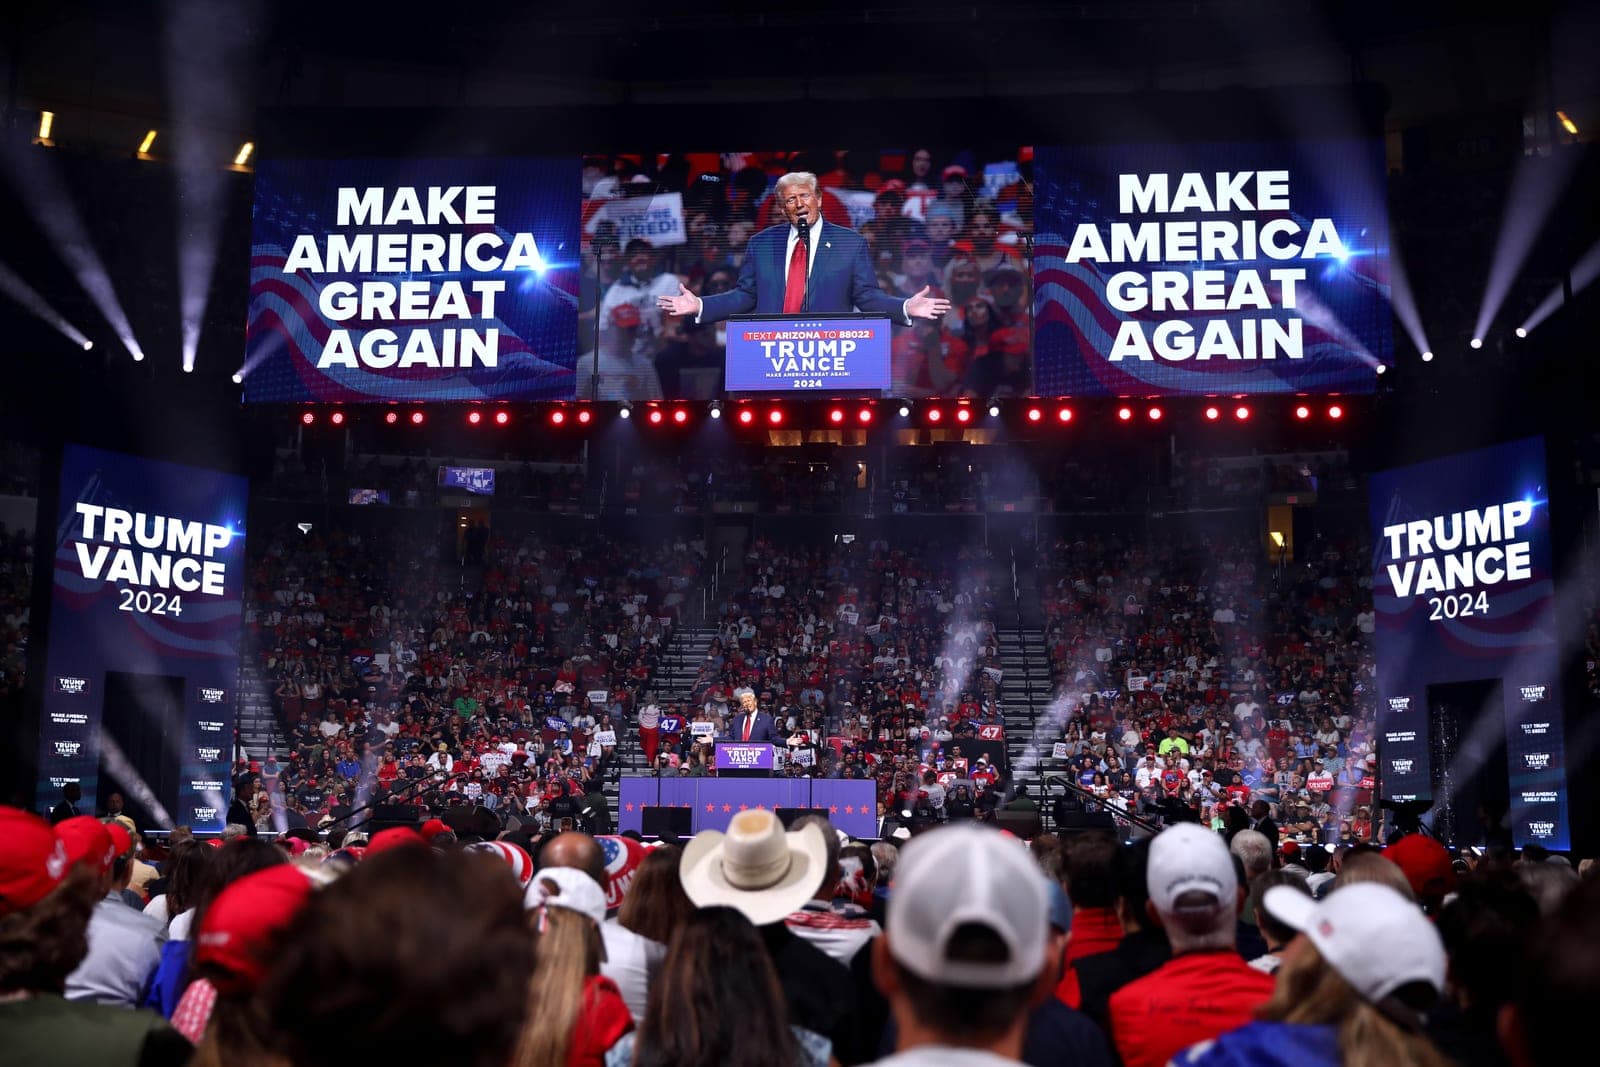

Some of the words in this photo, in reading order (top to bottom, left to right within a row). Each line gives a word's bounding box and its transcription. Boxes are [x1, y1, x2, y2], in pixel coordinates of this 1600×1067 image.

[336, 186, 496, 225] MAKE
[1119, 170, 1290, 213] MAKE
[283, 232, 544, 273] AMERICA
[1065, 218, 1346, 263] AMERICA
[319, 280, 505, 320] GREAT
[1106, 268, 1306, 312] GREAT
[317, 328, 499, 368] AGAIN
[748, 332, 772, 340] TEXT
[775, 331, 820, 340] ARIZONA
[839, 330, 870, 338] 88022
[760, 340, 857, 358] TRUMP
[1108, 318, 1304, 361] AGAIN
[771, 357, 845, 372] VANCE
[793, 379, 822, 388] 2024
[76, 502, 232, 557] TRUMP
[1384, 500, 1532, 559] TRUMP
[75, 542, 225, 596] VANCE
[1387, 541, 1531, 598] VANCE
[118, 589, 182, 616] 2024
[1428, 591, 1489, 621] 2024
[59, 678, 85, 686] TRUMP
[1520, 686, 1545, 694] TRUMP
[1277, 694, 1294, 704] 47
[661, 719, 678, 731] 47
[982, 727, 999, 738] 47
[727, 750, 761, 758] TRUMP
[1524, 753, 1550, 761] TRUMP
